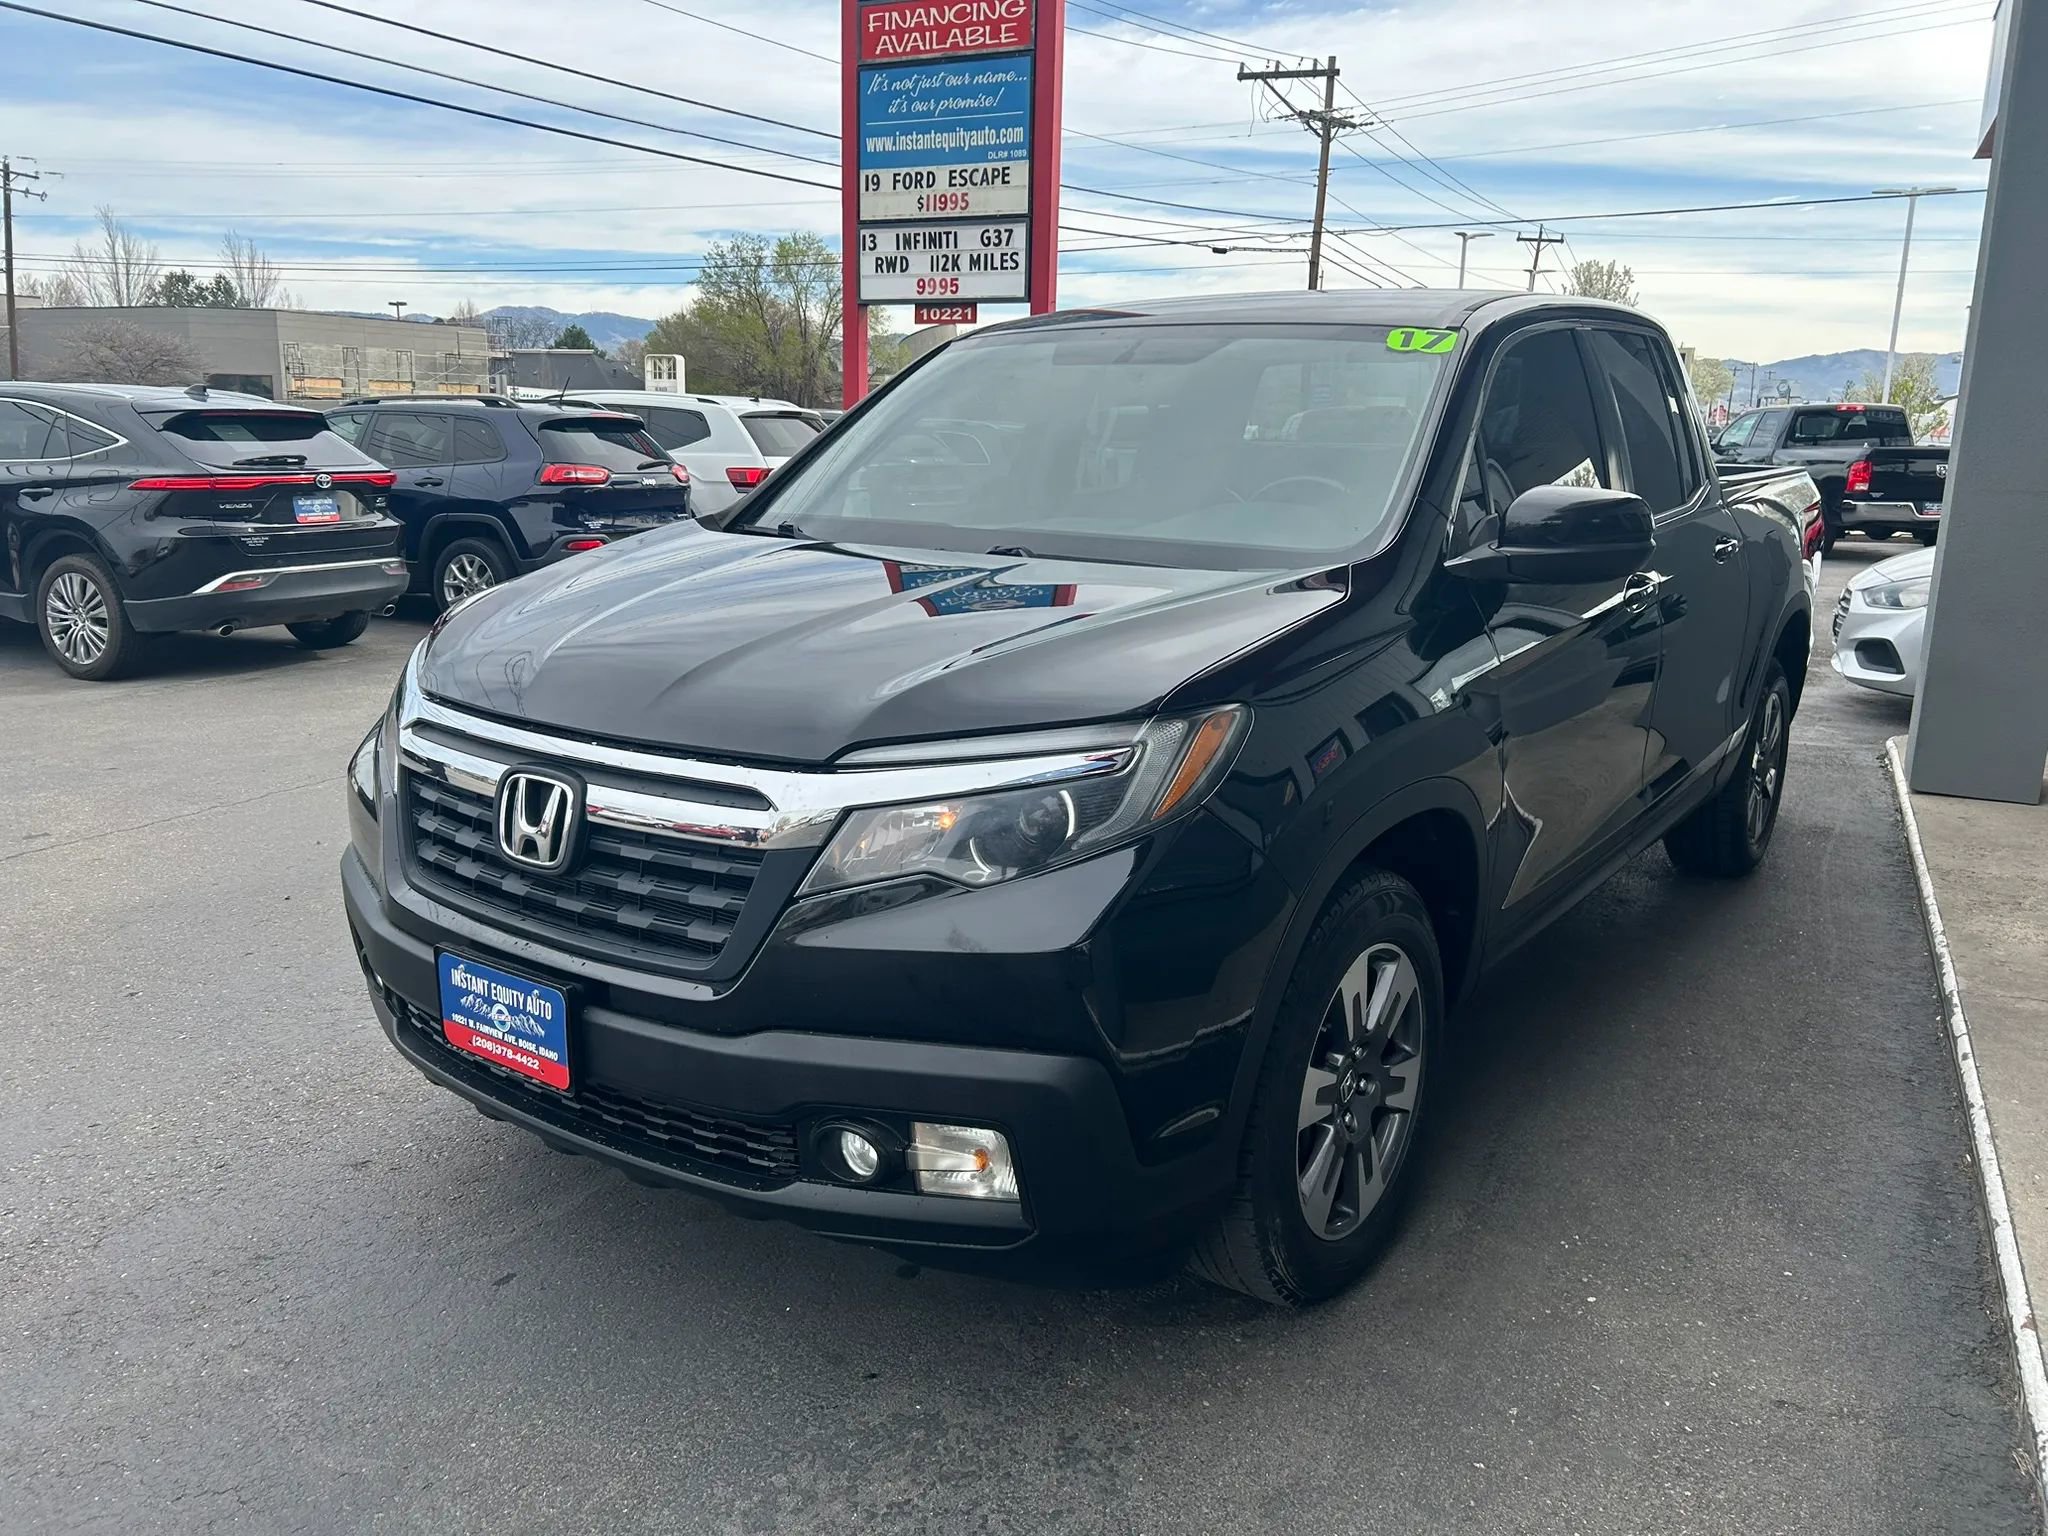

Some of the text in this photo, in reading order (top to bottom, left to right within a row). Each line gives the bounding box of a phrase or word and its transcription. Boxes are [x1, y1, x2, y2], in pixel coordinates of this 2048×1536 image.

[868, 0, 1027, 32] FINANCING
[875, 23, 1018, 54] AVAILABLE
[867, 72, 888, 95] It's
[891, 71, 918, 92] not
[911, 70, 944, 97] just
[945, 71, 971, 87] our
[888, 87, 1005, 117] it's our promise!
[865, 125, 1025, 153] www.instantequityauto.com
[987, 149, 1027, 160] DLR# 1089
[864, 166, 1011, 192] 19 FORD ESCAPE
[917, 192, 970, 213] $11995
[862, 228, 1014, 251] 13 INFINITI G37
[875, 252, 1020, 274] RWD 112K MILES
[916, 277, 960, 296] 9995
[919, 307, 973, 321] 10221
[1400, 331, 1452, 349] 17
[641, 477, 657, 486] Jeep
[451, 968, 552, 1020] INSTANT EQUITY AUTO
[472, 1035, 540, 1070] (208)378-4422
[476, 1021, 503, 1040] FAIRVIEW
[503, 1032, 517, 1046] AVE.
[518, 1037, 539, 1056] BOISE,
[539, 1046, 558, 1061] IDAHO
